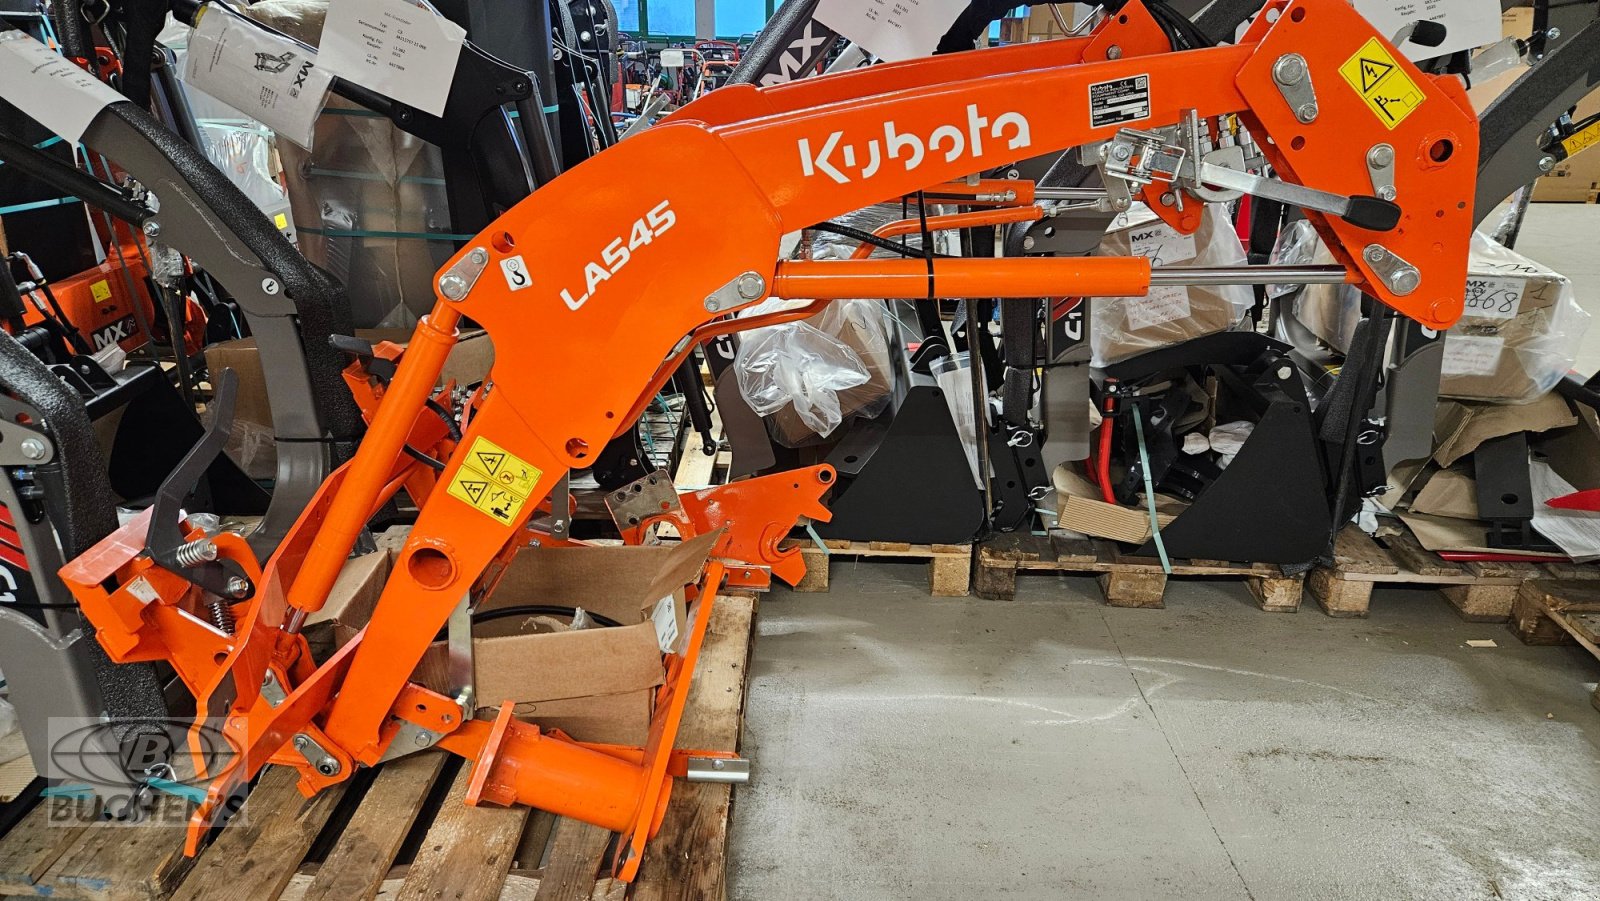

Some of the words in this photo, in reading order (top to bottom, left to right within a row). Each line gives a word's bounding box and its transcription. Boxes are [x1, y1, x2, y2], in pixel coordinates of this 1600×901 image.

[293, 60, 315, 89] MX
[760, 19, 827, 87] MX
[797, 103, 1031, 184] Kubota
[559, 199, 676, 311] LA545
[1131, 230, 1154, 242] MX
[93, 320, 127, 350] MX
